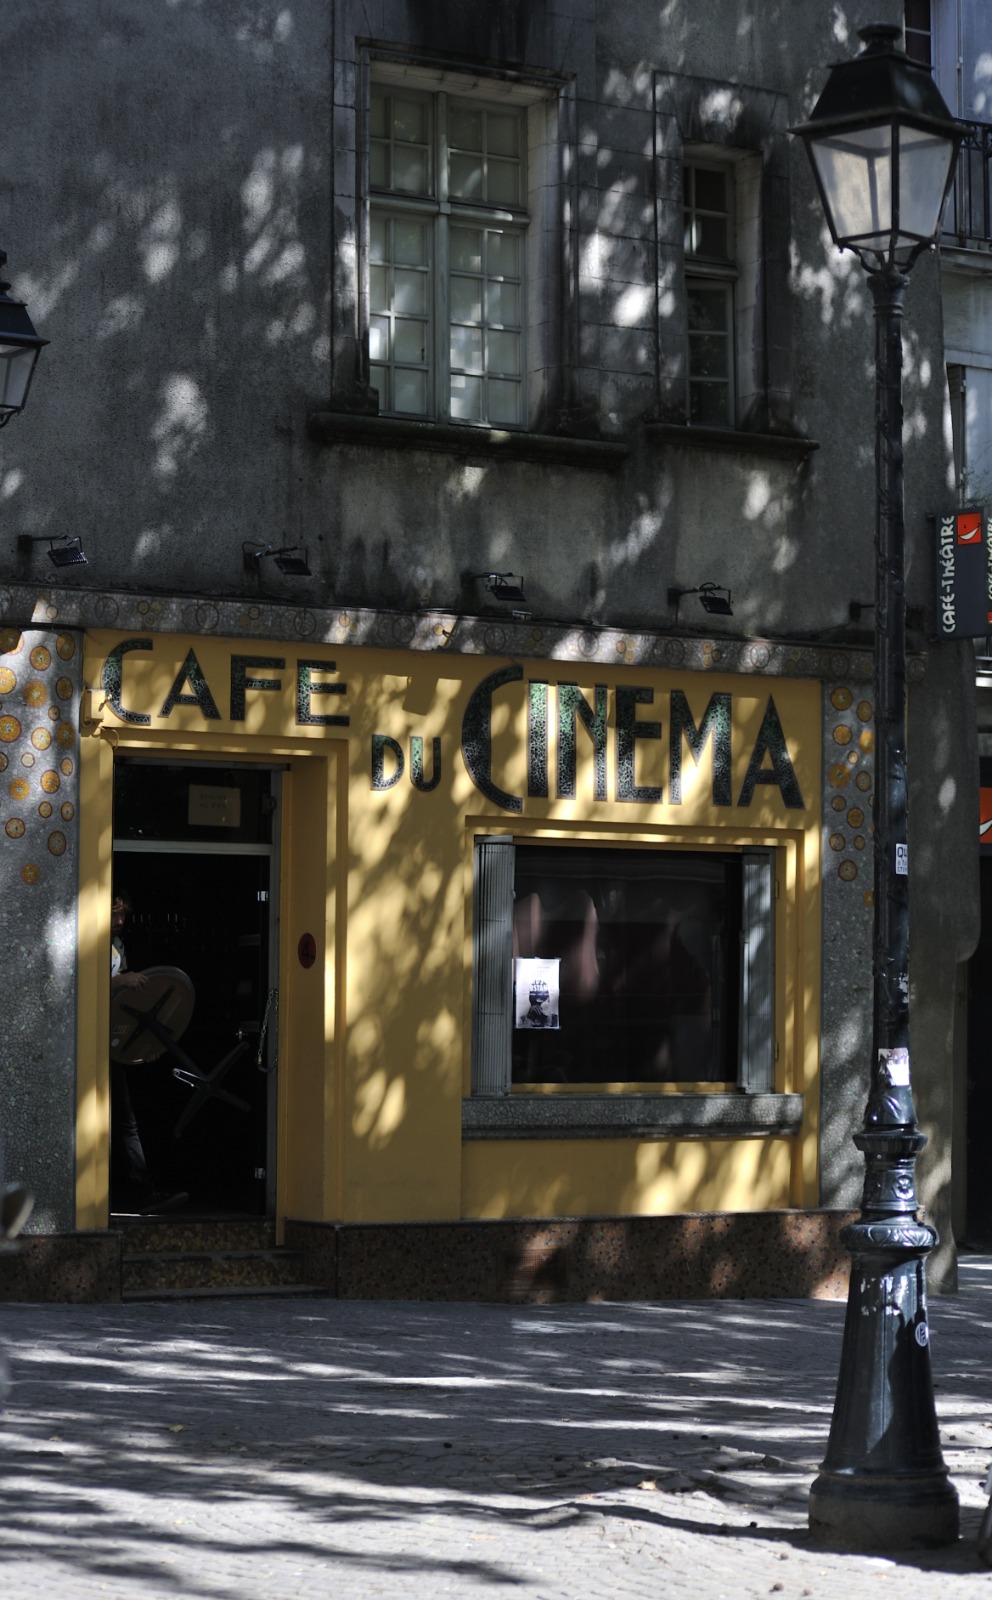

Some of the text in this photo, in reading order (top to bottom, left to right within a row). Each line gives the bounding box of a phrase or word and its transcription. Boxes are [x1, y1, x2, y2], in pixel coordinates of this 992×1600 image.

[101, 638, 805, 814] CAFE DU CINEMA
